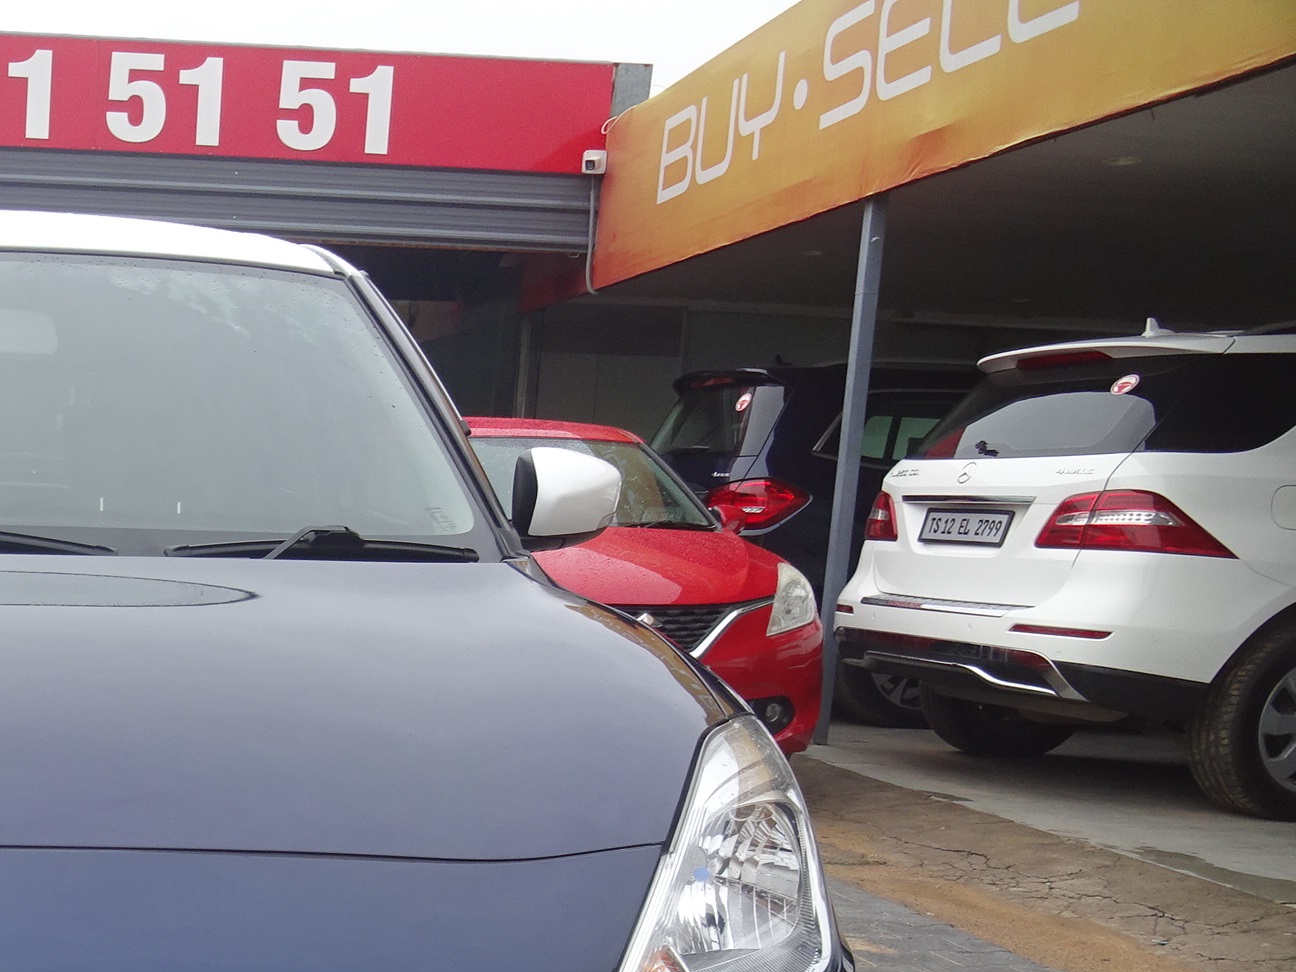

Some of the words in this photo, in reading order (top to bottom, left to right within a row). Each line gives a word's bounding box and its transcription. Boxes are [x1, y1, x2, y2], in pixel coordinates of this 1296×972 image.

[105, 51, 224, 147] 51
[276, 59, 395, 155] 51
[957, 518, 971, 536] EL
[973, 519, 1003, 538] 2799
